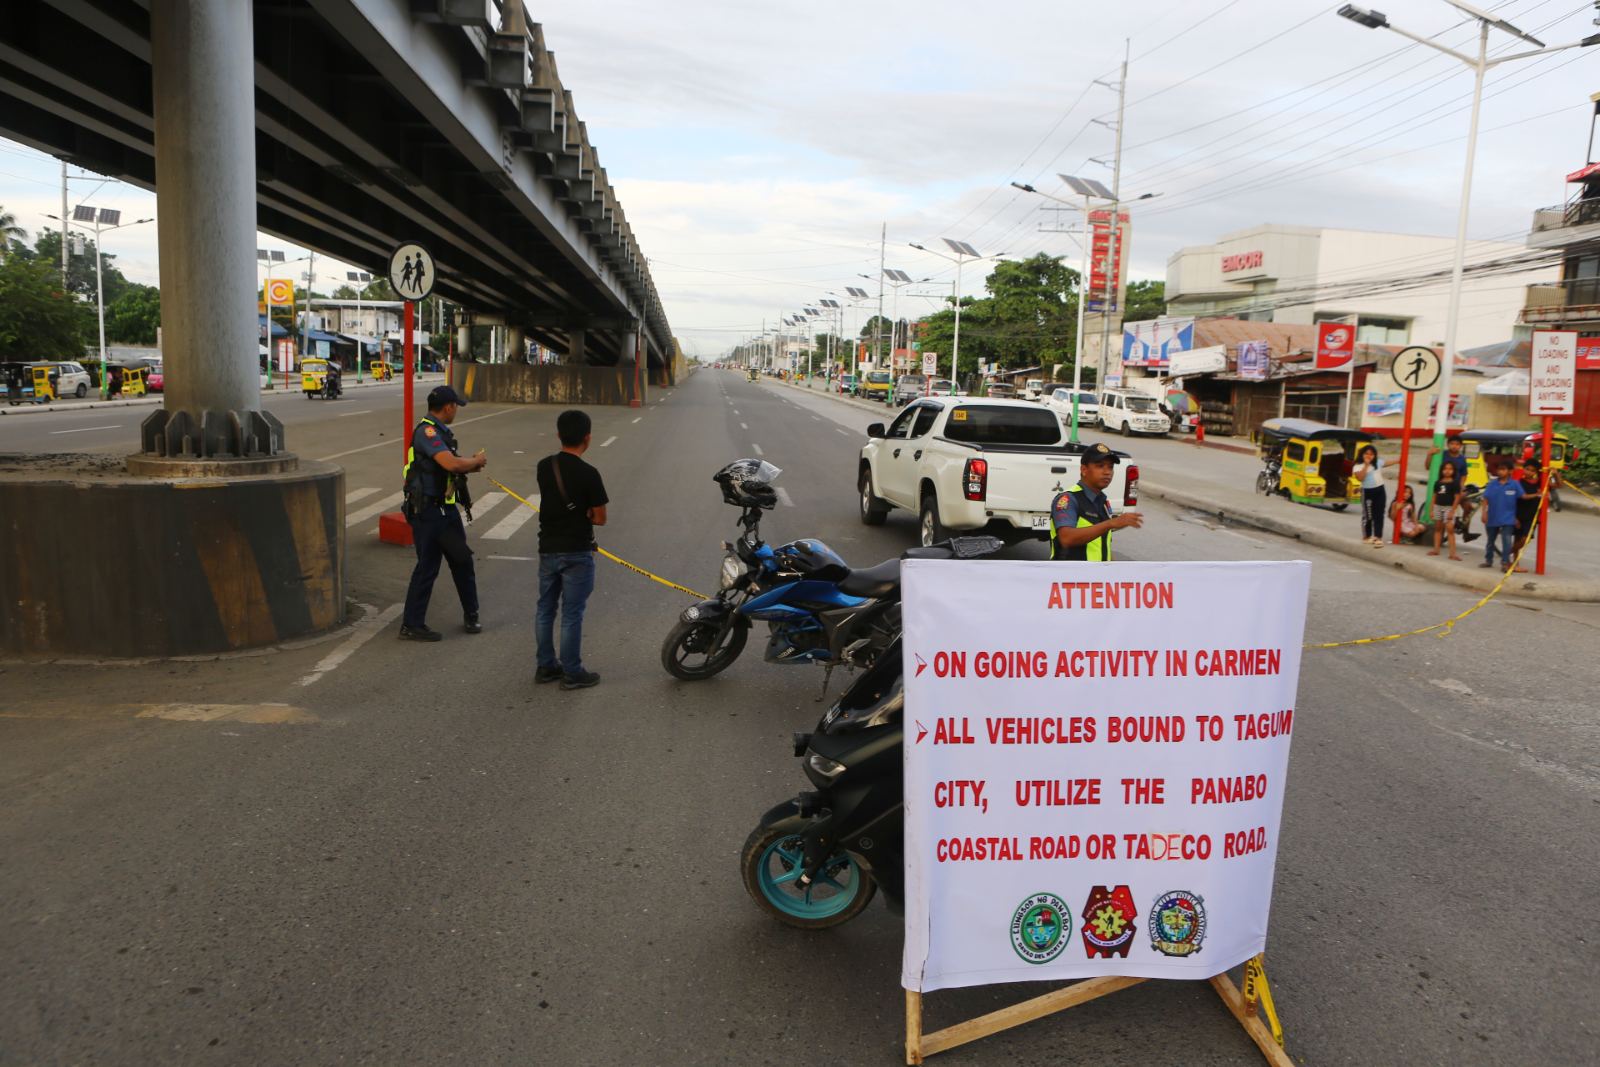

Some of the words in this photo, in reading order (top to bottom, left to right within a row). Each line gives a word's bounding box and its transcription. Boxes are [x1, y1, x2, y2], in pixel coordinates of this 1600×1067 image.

[1550, 335, 1559, 345] NO
[1538, 349, 1568, 359] LOADING
[1546, 365, 1560, 374] AND
[1533, 378, 1572, 388] UNLOADING
[1537, 391, 1567, 402] ANYTIME
[1048, 582, 1173, 608] ATTENTION
[934, 651, 966, 678] ON
[974, 651, 1048, 678] GOING
[1055, 650, 1158, 678] ACTIVITY
[1166, 649, 1188, 677] IN
[1195, 648, 1280, 677] CARMEN
[934, 718, 976, 745] ALL
[986, 717, 1096, 745] VEHICLES
[1106, 715, 1186, 743] BOUND
[1195, 715, 1225, 742] TO
[1234, 710, 1293, 740] TAGUM
[934, 780, 989, 813] CITY,
[1015, 779, 1101, 806] UTILIZE
[1121, 778, 1165, 805] THE
[1190, 774, 1267, 805] PANABO
[937, 837, 1024, 863] COASTAL
[1029, 835, 1080, 861] ROAD
[1086, 834, 1117, 860] OR
[1123, 833, 1213, 860] TADECO
[1224, 826, 1267, 859] ROAD.
